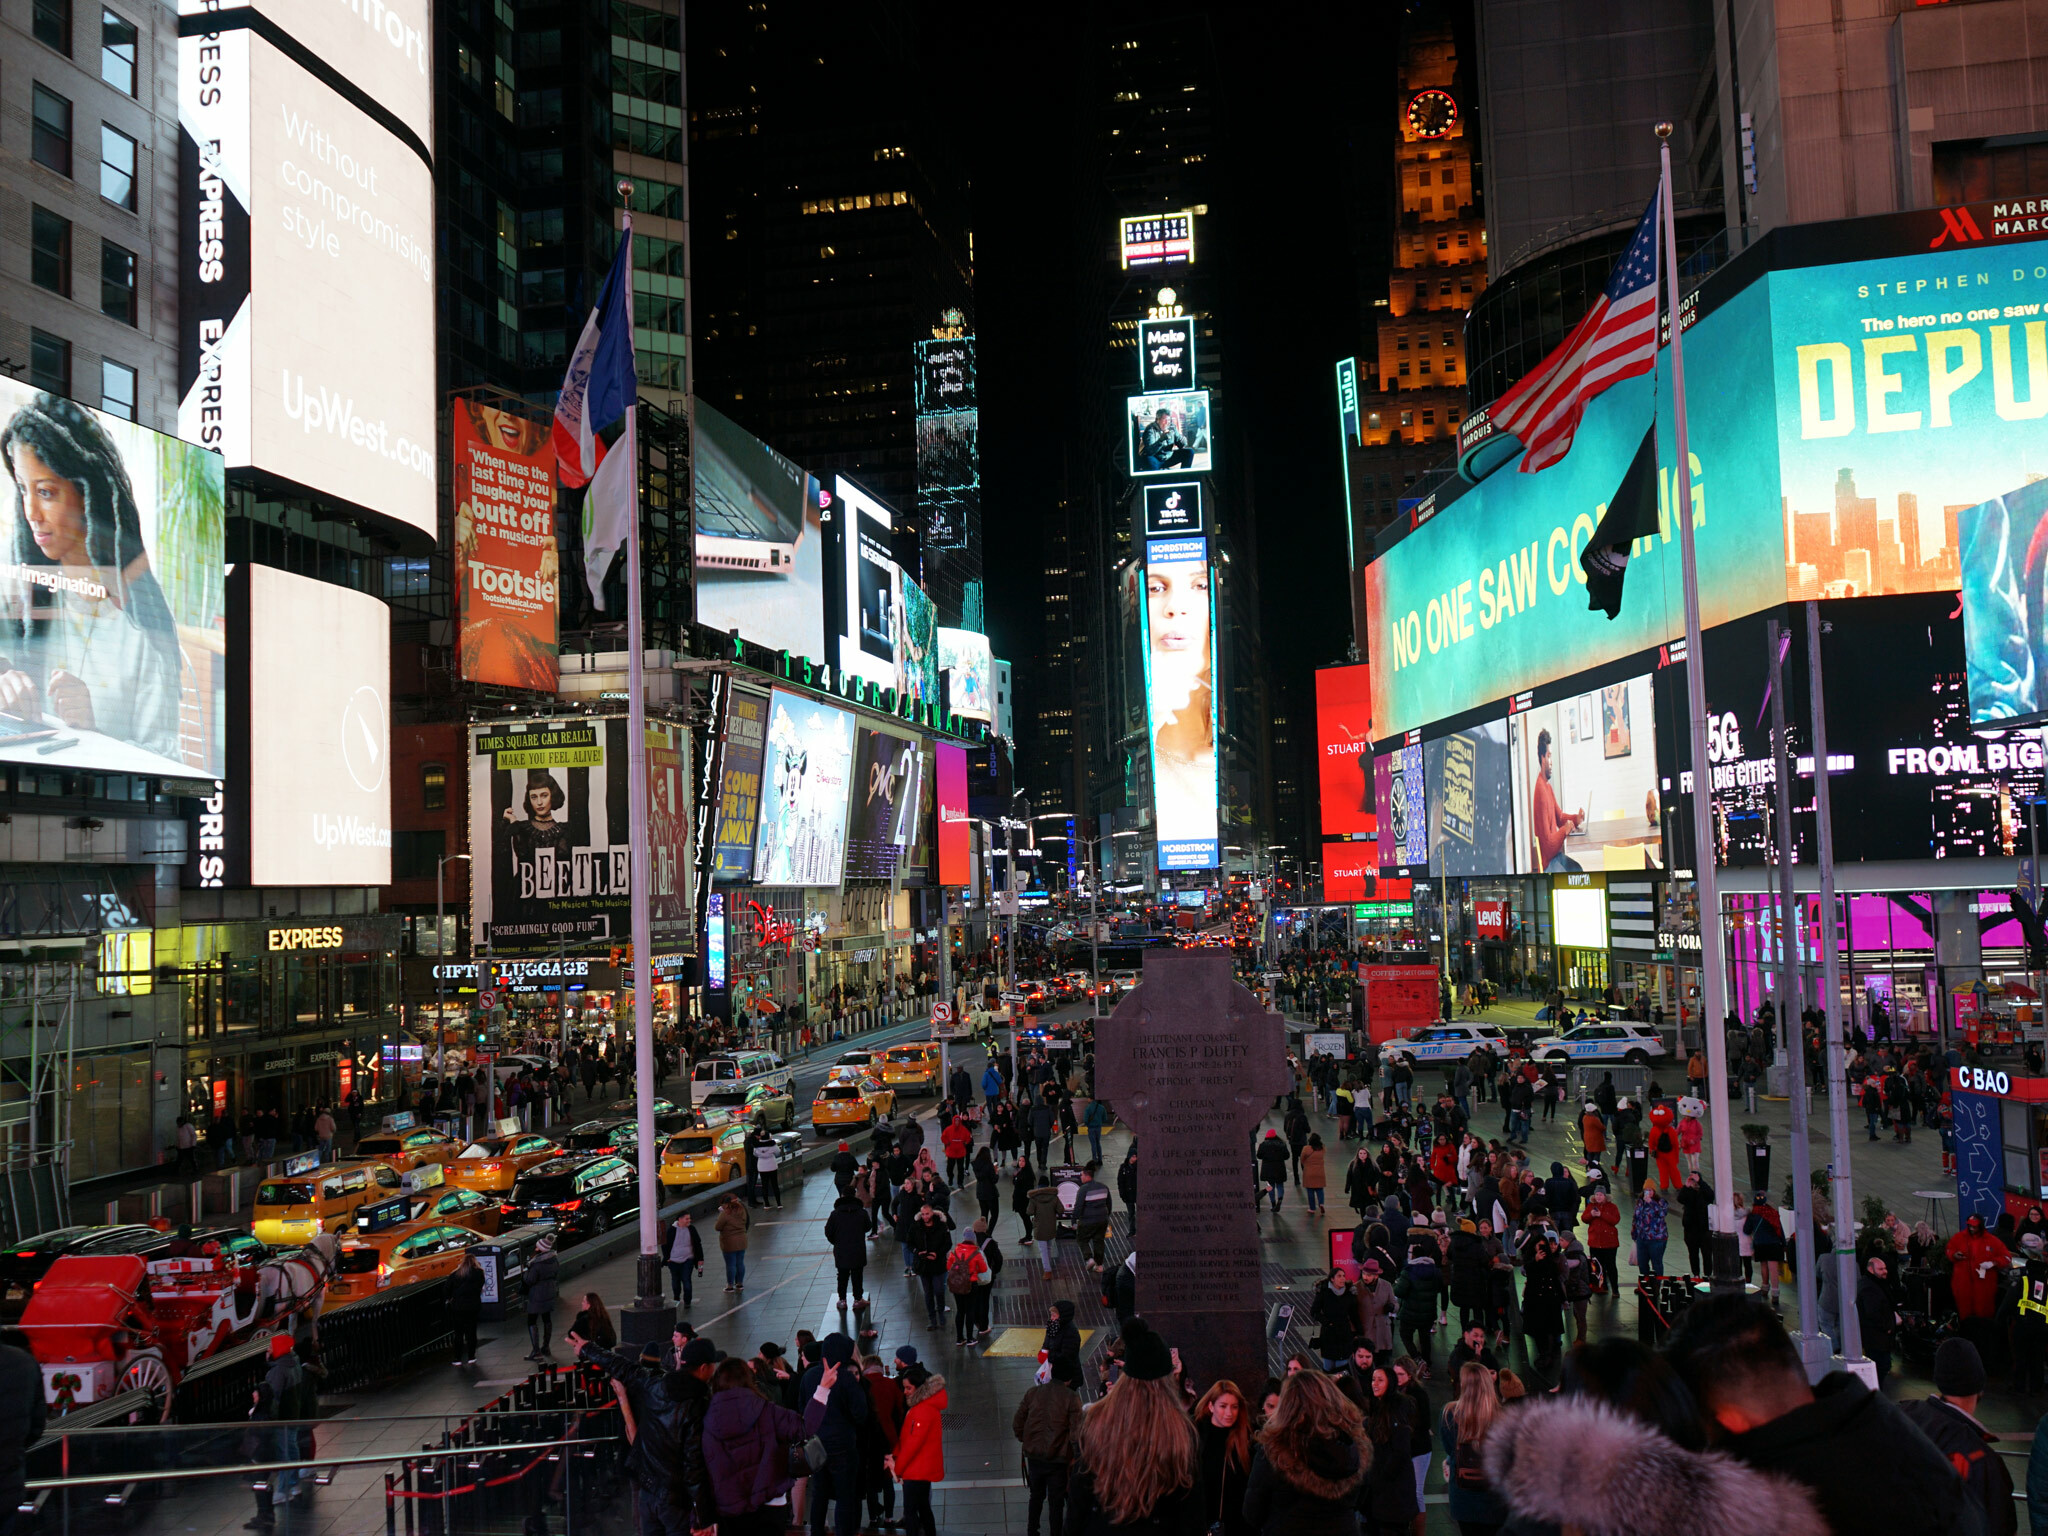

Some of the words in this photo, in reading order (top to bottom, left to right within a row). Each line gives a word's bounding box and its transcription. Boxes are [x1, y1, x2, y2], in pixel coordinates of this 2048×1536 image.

[282, 104, 378, 196] Without
[199, 139, 223, 283] EXPRESS
[282, 160, 431, 282] compromising
[282, 208, 341, 258] style
[1858, 272, 1988, 298] STEPHEN
[1148, 305, 1184, 320] 2019
[1861, 318, 1894, 332] The
[1897, 314, 1937, 329] hero
[1940, 311, 1962, 325] no
[1966, 307, 1999, 322] one
[2003, 303, 2039, 317] saw
[1147, 330, 1186, 345] Make
[1151, 346, 1183, 363] your
[1153, 362, 1183, 377] day.
[1796, 321, 2047, 440] DEPU
[1342, 370, 1355, 413] hulu
[283, 369, 434, 482] UpWest.com
[1463, 422, 1492, 450] MARQUIS
[471, 462, 495, 482] last
[498, 471, 525, 490] time
[528, 480, 549, 496] you
[508, 462, 529, 477] was
[531, 466, 549, 482] the
[471, 479, 521, 504] laughed
[523, 495, 550, 511] your
[471, 495, 518, 528] butt
[520, 511, 550, 535] off
[1160, 509, 1186, 518] TikTok
[1418, 505, 1435, 524] MARQUIS
[476, 523, 488, 535] at
[489, 526, 497, 537] a
[1151, 542, 1203, 554] NORDSTROM
[21, 563, 107, 598] imagination
[468, 560, 554, 602] Tootsie
[482, 592, 544, 611] TootsieMusical.com
[1393, 609, 1421, 671] NO
[1425, 580, 1474, 654] ONE
[1479, 541, 1538, 630] SAW
[784, 649, 847, 697] 1540
[855, 675, 963, 738] BROADWAY
[729, 715, 743, 735] BEST
[742, 718, 762, 740] MUSICAL
[479, 737, 504, 750] TIMES
[506, 733, 539, 749] SQUARE
[541, 732, 558, 746] CAN
[560, 729, 593, 745] REALLY
[1708, 711, 1741, 762] 5G
[1327, 742, 1365, 756] STUART
[1889, 744, 1978, 774] FROM
[1986, 741, 2044, 770] BIG
[501, 753, 525, 766] MAKE
[528, 752, 545, 764] YOU
[548, 751, 570, 764] FEEL
[573, 750, 601, 763] ALIVE!
[724, 769, 758, 797] COME
[1714, 764, 1735, 790] BIG
[894, 748, 923, 845] 21
[718, 819, 755, 845] AWAY
[1162, 843, 1215, 853] NORDSTROM
[520, 845, 630, 899] BEETLE
[1334, 869, 1362, 878] STUART
[548, 900, 560, 909] The
[561, 900, 589, 910] Musical.
[591, 900, 604, 909] The
[552, 922, 574, 934] GOOD
[268, 926, 343, 951] EXPRESS
[500, 961, 589, 977] LUGGAGE
[1140, 1034, 1192, 1044] LIEUTENANT
[1196, 1033, 1240, 1042] COLONEL
[1314, 1041, 1345, 1051] FROZEN
[310, 1051, 340, 1064] EXPRESS
[1133, 1047, 1187, 1059] FRANCIS
[1191, 1046, 1198, 1058] P
[1203, 1045, 1249, 1057] DUFFY
[1421, 1045, 1443, 1055] NYPD
[1575, 1044, 1599, 1054] NYPD
[264, 1058, 296, 1071] EXPRESS
[1148, 1078, 1195, 1086] CATHOLIC
[1200, 1076, 1235, 1085] PRIEST
[1959, 1066, 1970, 1088] C
[1974, 1069, 2010, 1094] BAO
[1170, 1099, 1215, 1109] CHAPLAIN
[1196, 1112, 1237, 1121] INFANTRY
[1151, 1150, 1159, 1158] A
[1163, 1150, 1181, 1158] LIFE
[1185, 1149, 1198, 1157] OF
[1200, 1149, 1239, 1157] SERVICE
[1148, 1168, 1171, 1177] GOD
[1174, 1168, 1194, 1176] AND
[1197, 1167, 1241, 1176] COUNTRY
[1226, 1191, 1245, 1199] WAR
[1226, 1202, 1256, 1210] GUARD
[1169, 1225, 1201, 1233] WORLD
[1205, 1224, 1224, 1232] WAR
[1200, 1249, 1230, 1257] SERVICE
[1232, 1248, 1259, 1256] CROSS
[1138, 1260, 1196, 1269] DISTINGUISHED
[1200, 1260, 1230, 1268] SERVICE
[1232, 1259, 1260, 1267] MEDAL
[485, 1260, 495, 1297] FROZEN
[1138, 1272, 1196, 1280] CONSPICUOUS
[1200, 1271, 1230, 1279] SERVICE
[1232, 1270, 1260, 1278] CROSS
[1160, 1294, 1186, 1302] CROIX
